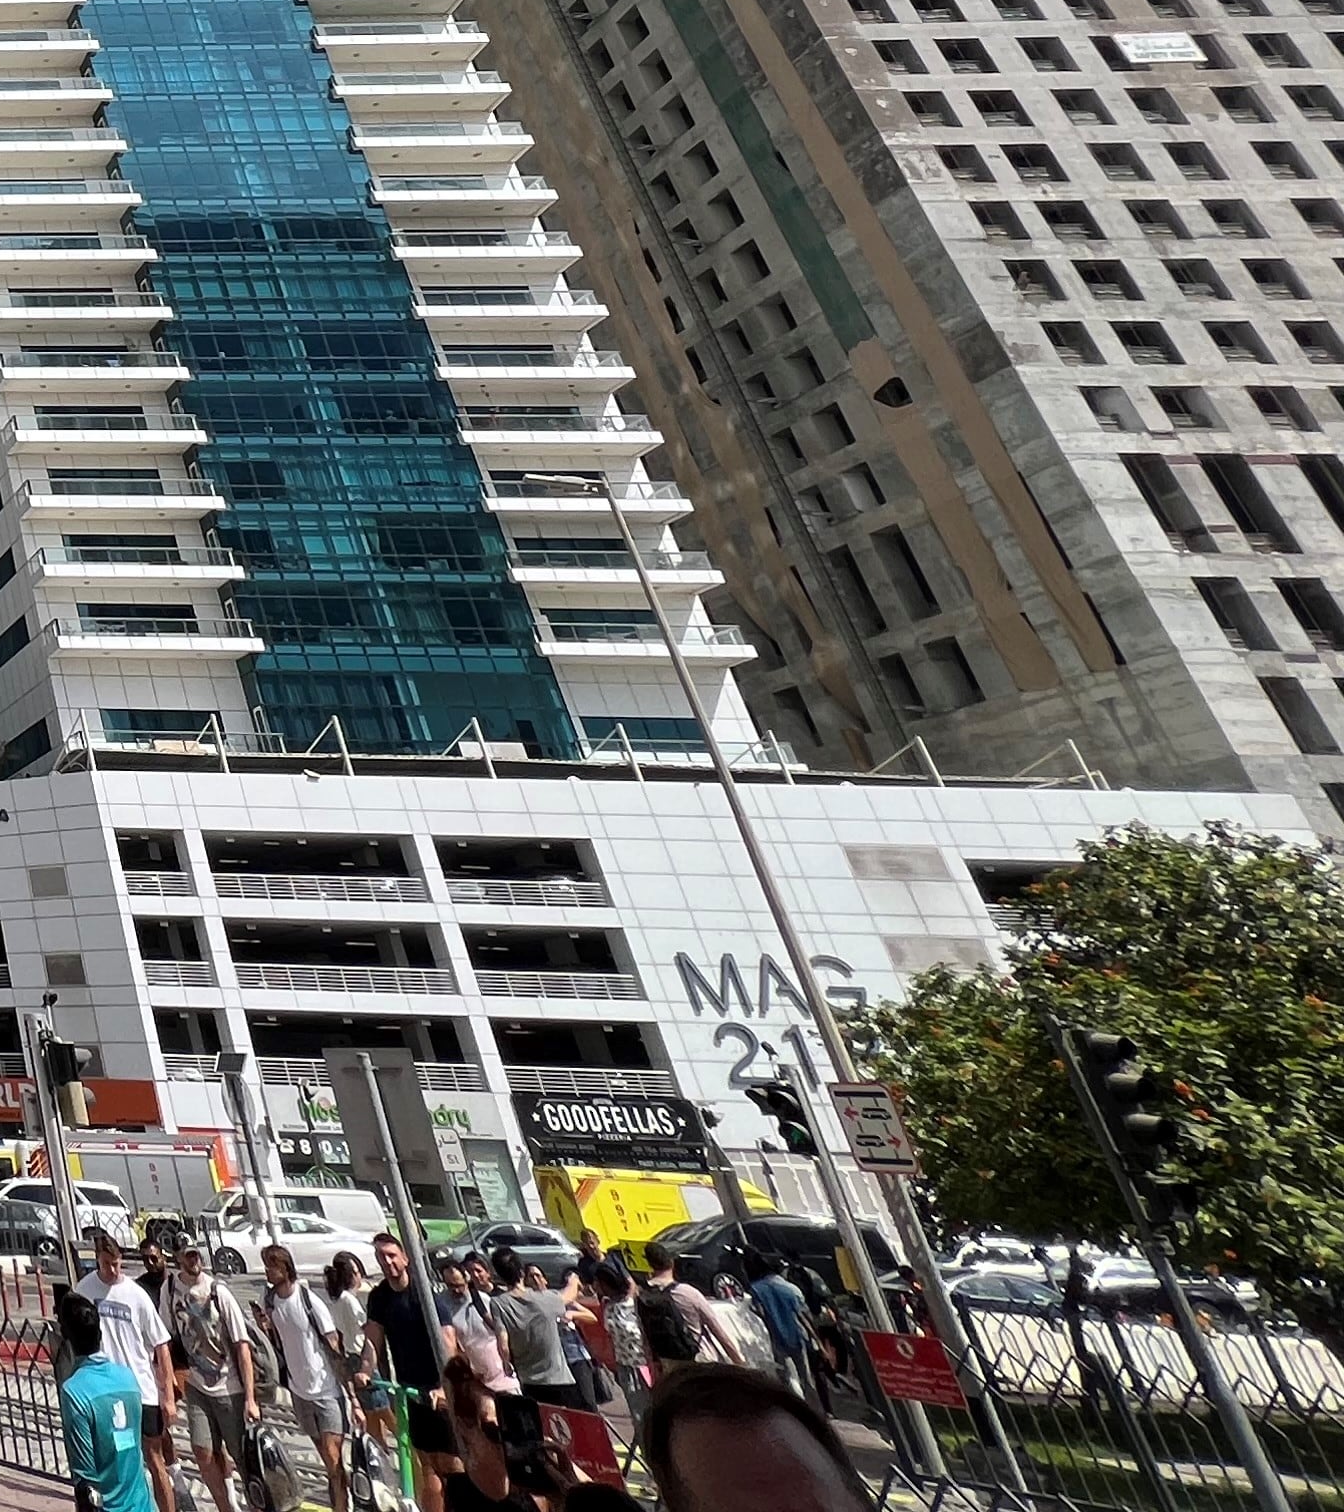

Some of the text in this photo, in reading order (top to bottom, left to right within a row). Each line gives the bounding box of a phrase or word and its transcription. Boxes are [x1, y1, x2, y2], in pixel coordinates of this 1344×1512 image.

[674, 951, 867, 1020] MAG
[714, 1021, 829, 1094] 21
[543, 1103, 676, 1136] GOODFELLAS
